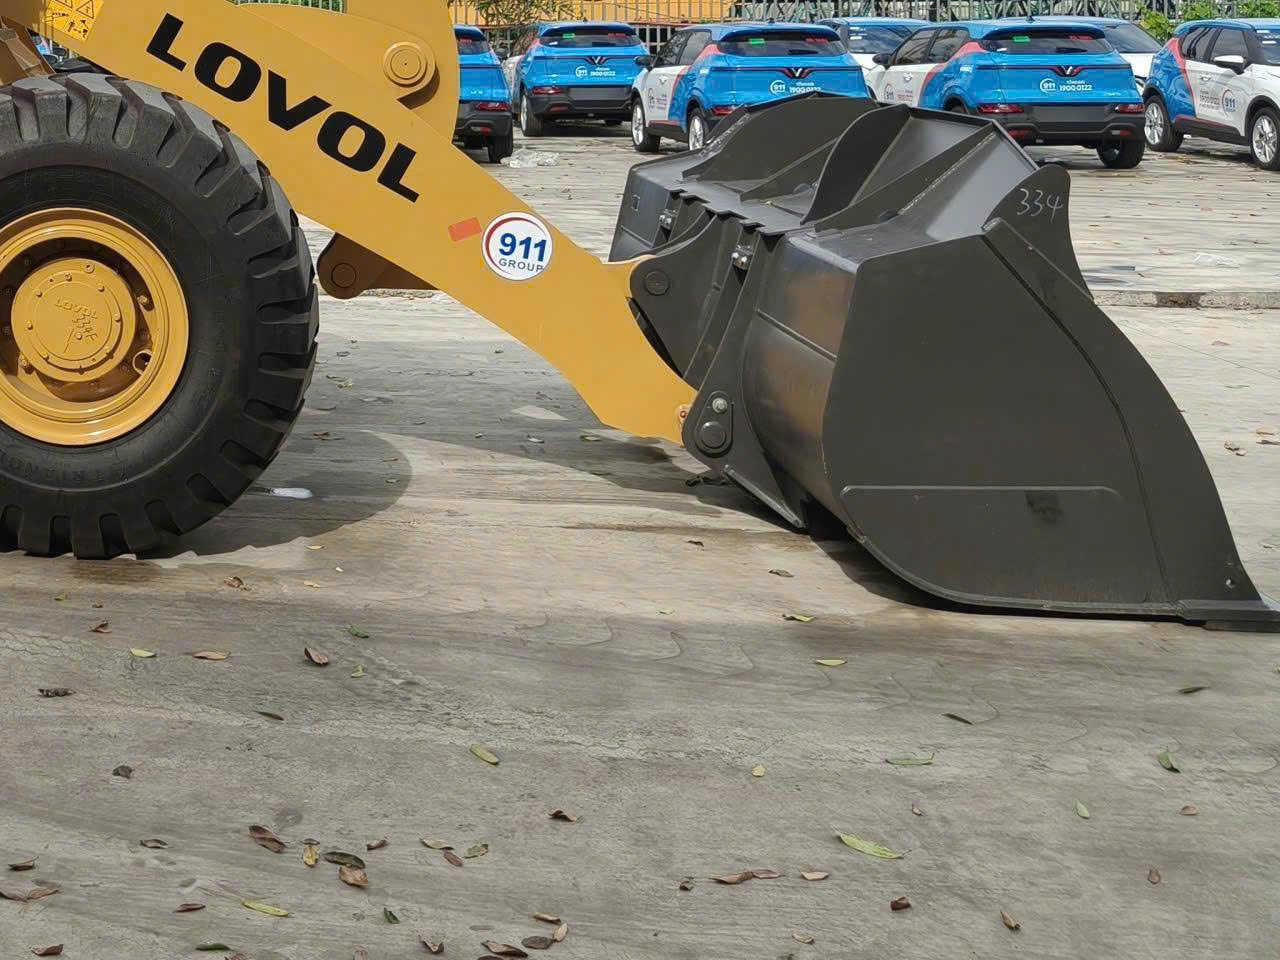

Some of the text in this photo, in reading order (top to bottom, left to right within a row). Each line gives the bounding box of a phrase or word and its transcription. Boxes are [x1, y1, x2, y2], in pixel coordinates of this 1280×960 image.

[1059, 84, 1093, 92] 1900 0122
[145, 12, 420, 204] LOVOL
[1224, 97, 1236, 109] 911
[1017, 188, 1064, 224] 334
[499, 232, 548, 263] 911
[498, 257, 545, 273] GROUP
